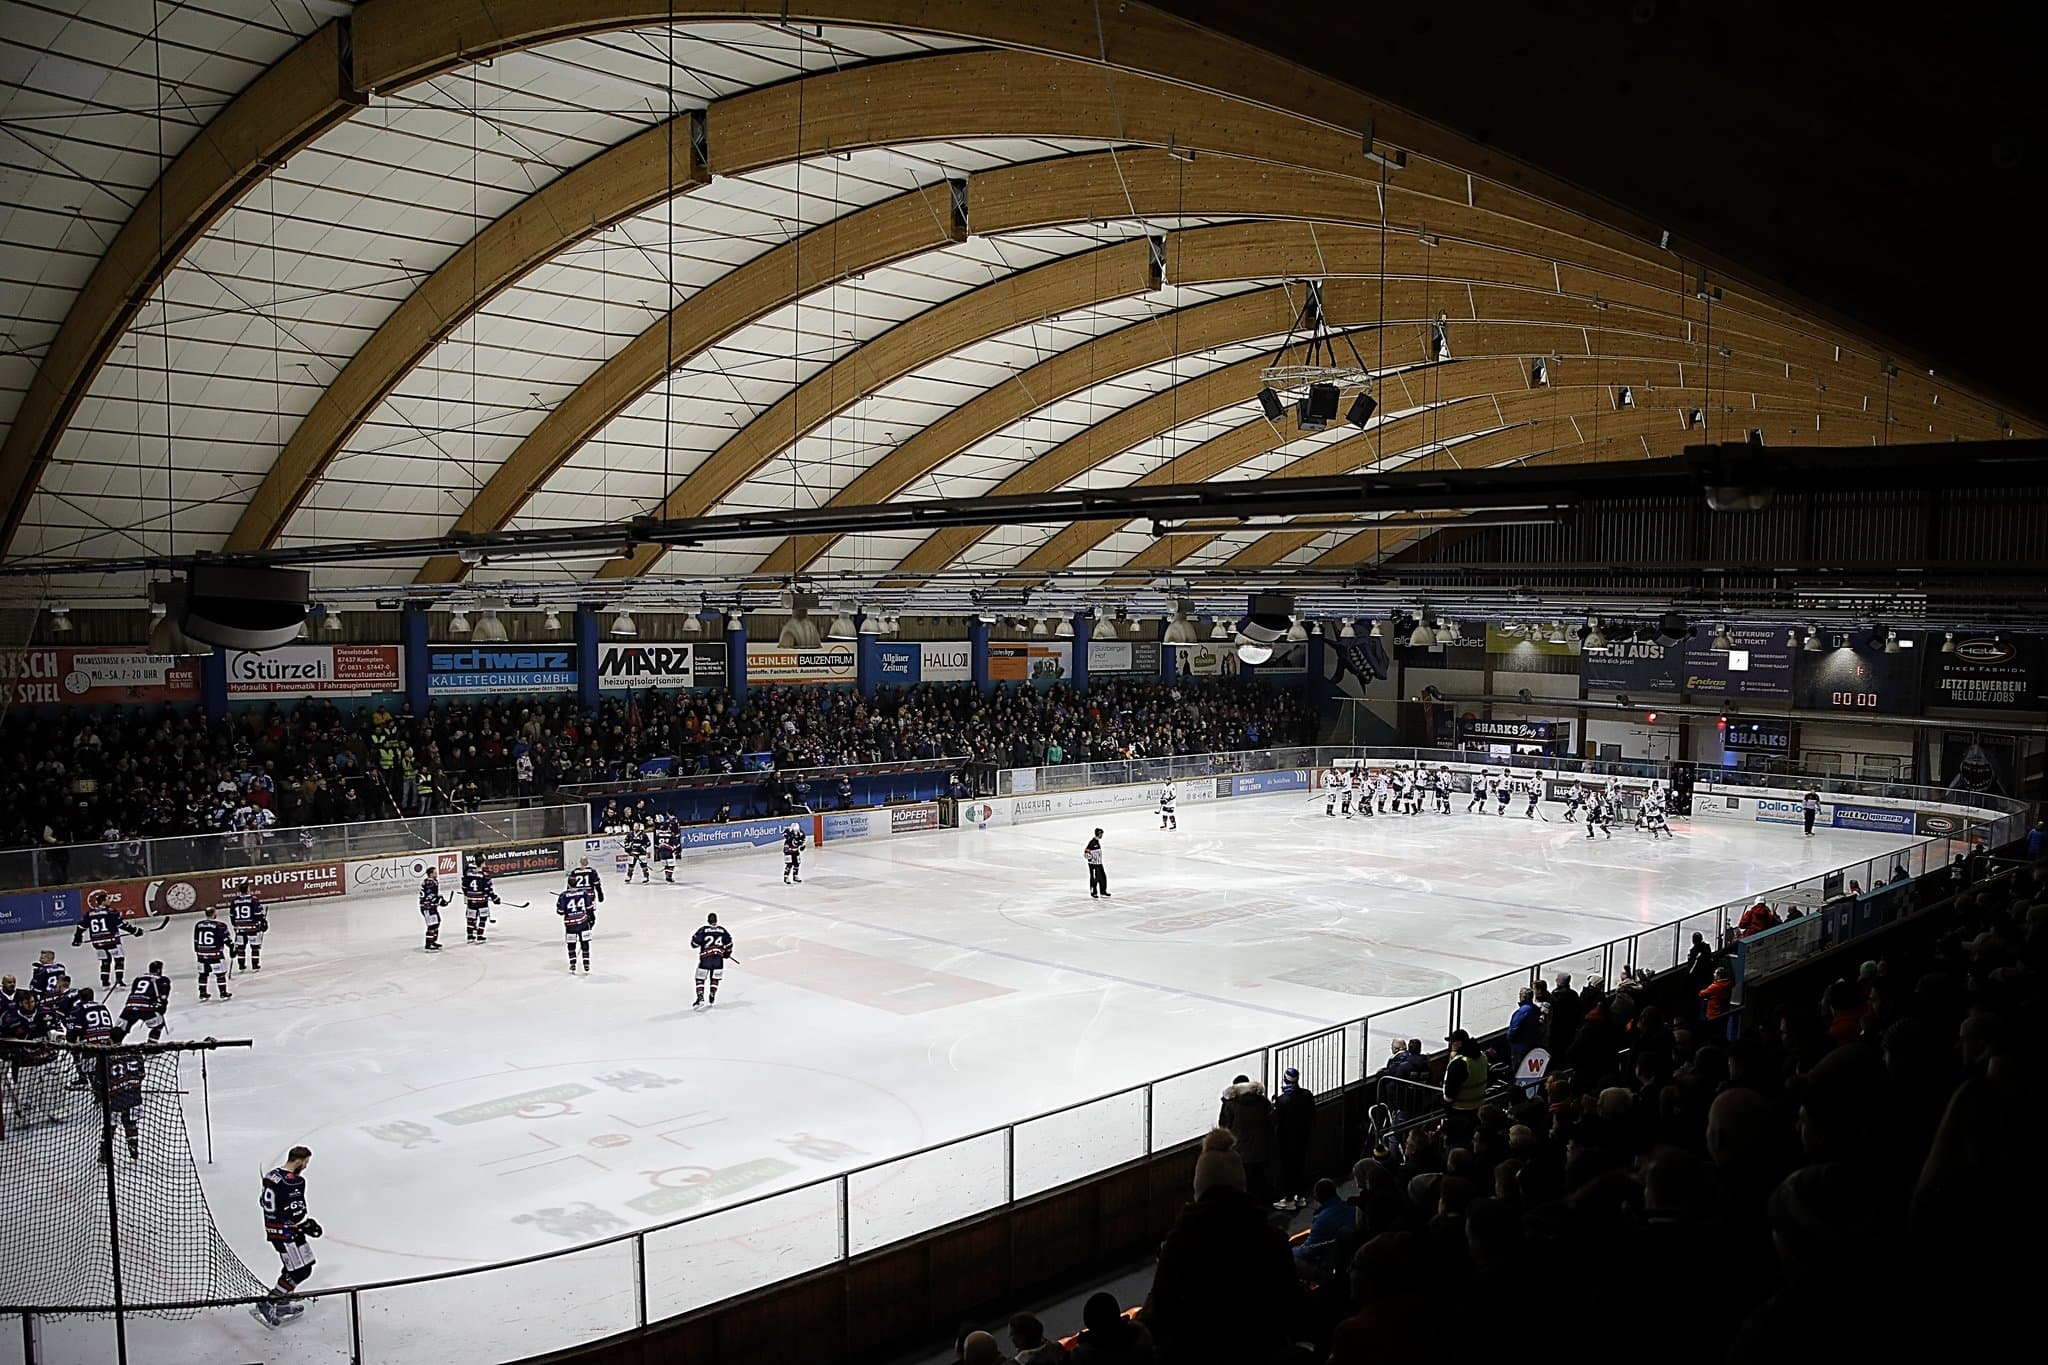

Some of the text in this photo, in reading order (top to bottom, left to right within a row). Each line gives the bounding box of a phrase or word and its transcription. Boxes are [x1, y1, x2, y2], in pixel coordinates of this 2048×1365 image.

[882, 653, 910, 664] Allgäuer
[1628, 644, 1665, 659] AUS!
[746, 655, 853, 666] KLEINLEIN BAUZENTRUM
[243, 658, 321, 680] Stürzel
[882, 662, 910, 674] Zeitung
[169, 671, 193, 681] REWE
[431, 673, 569, 687] KÄLTETECHNIK GMBH
[230, 680, 398, 692] Hydraulik Pneumatik Fahrzeuginstrumente
[1941, 678, 2027, 693] JETZT BEWERBEN!
[17, 683, 61, 704] SPIEL
[1474, 722, 1519, 736] SHARKS
[1729, 732, 1788, 747] SHARKS
[1758, 800, 1789, 812] Dalla
[892, 809, 928, 821] HÖPFER
[688, 830, 729, 843] Volltreffer
[731, 829, 742, 838] im
[743, 826, 777, 840] Allgäuer
[488, 852, 507, 861] nicht
[508, 849, 538, 859] Wurscht
[440, 857, 456, 873] illy
[523, 857, 559, 870] Kohler
[221, 866, 338, 889] KFZ-PRÜFSTELLE
[303, 879, 338, 890] Kempten
[575, 875, 590, 887] 21
[470, 879, 479, 891] 4
[566, 897, 586, 912] 44
[234, 905, 251, 920] 19
[90, 917, 109, 933] 61
[198, 931, 215, 945] 16
[703, 935, 724, 949] 24
[134, 979, 151, 994] 9
[85, 1010, 112, 1028] 96
